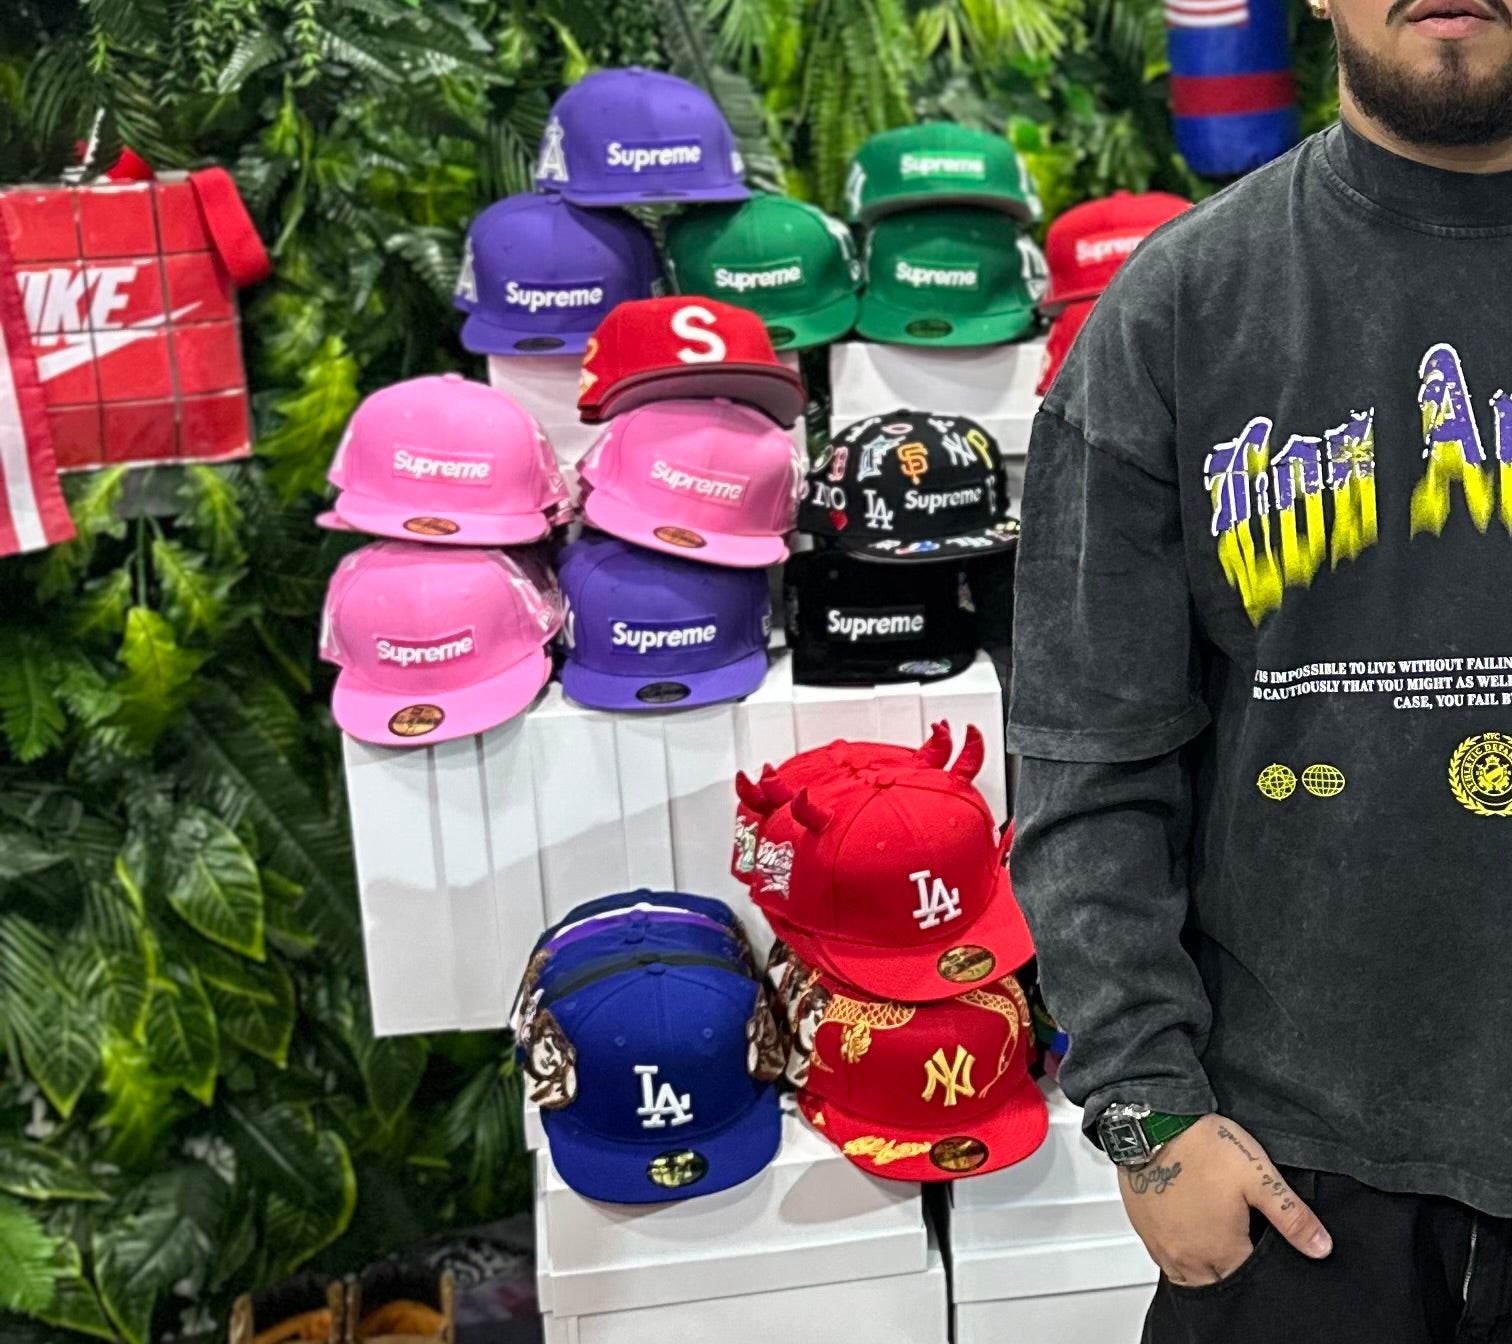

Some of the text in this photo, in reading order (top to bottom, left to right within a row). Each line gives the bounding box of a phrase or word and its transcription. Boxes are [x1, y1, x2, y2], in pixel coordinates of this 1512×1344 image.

[607, 142, 701, 172] Supreme
[900, 154, 985, 177] Supreme
[1075, 236, 1145, 264] Suprem
[714, 266, 802, 292] Supreme
[895, 262, 977, 287] Supreme
[505, 281, 604, 313] Supreme
[671, 305, 727, 364] S
[393, 449, 490, 480] Supreme
[650, 460, 744, 501] Supreme
[863, 488, 894, 531] LA
[904, 487, 982, 514] Supreme
[612, 621, 717, 654] Supreme
[827, 609, 925, 641] Supreme
[375, 636, 474, 668] Supreme
[1270, 662, 1347, 684] IMPOSSIBLE
[1349, 662, 1365, 675] TO
[1367, 661, 1396, 675] LIVE
[1398, 658, 1464, 673] WITHOUT
[1263, 680, 1341, 700] CAUTIOUSLY
[1342, 679, 1375, 693] THAT
[1376, 678, 1404, 692] YOU
[1407, 676, 1453, 691] MIGHT
[1456, 675, 1475, 689] AS
[1393, 695, 1433, 710] CASE,
[1435, 694, 1465, 707] YOU
[1467, 693, 1499, 706] FAIL
[909, 870, 962, 929] LA
[921, 1044, 976, 1107] NY
[633, 1065, 694, 1129] LA
